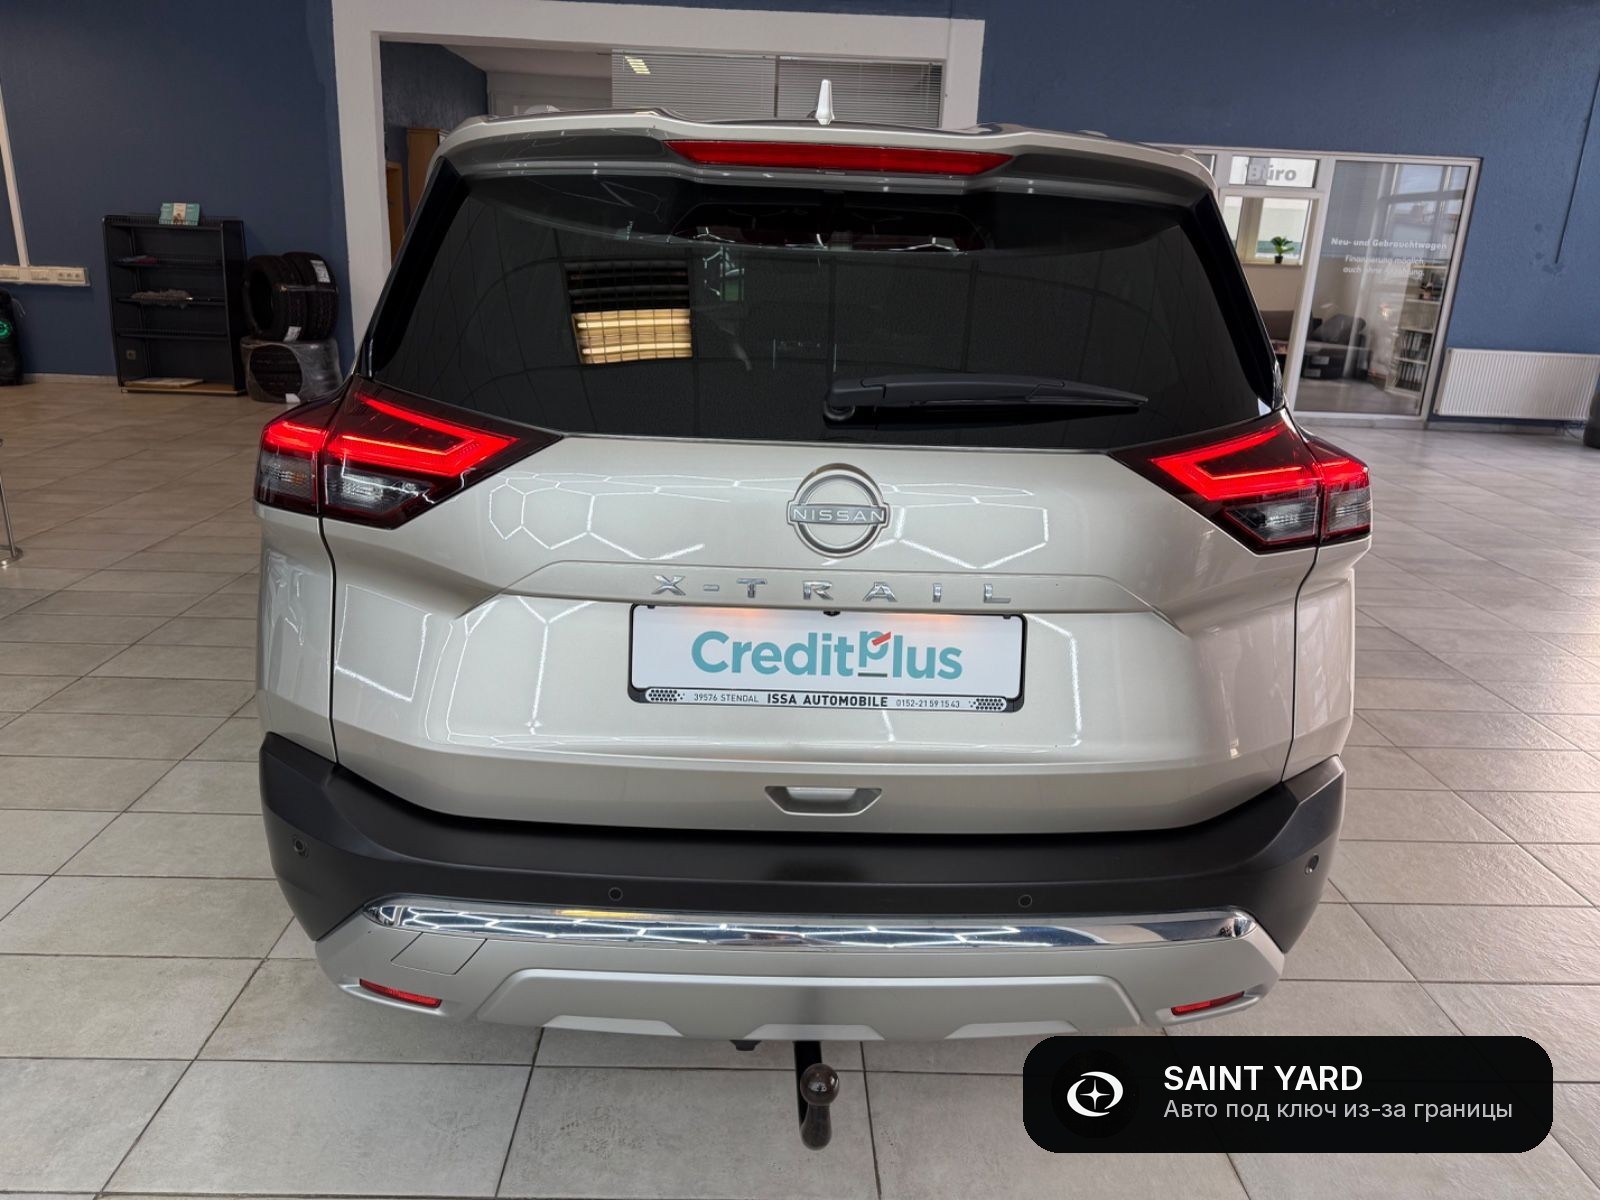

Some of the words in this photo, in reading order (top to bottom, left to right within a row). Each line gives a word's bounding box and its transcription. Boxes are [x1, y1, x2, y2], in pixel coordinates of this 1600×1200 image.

[1331, 237, 1352, 246] Neu-
[1353, 239, 1371, 248] und
[1372, 239, 1447, 251] Gebrauchtwagen
[793, 508, 885, 521] NISSAN
[652, 575, 1011, 603] X-TRAIL
[694, 693, 718, 702] 39576
[720, 694, 759, 703] STENDAL
[767, 693, 797, 705] ISSA
[803, 695, 888, 708] AUTOMOBILE
